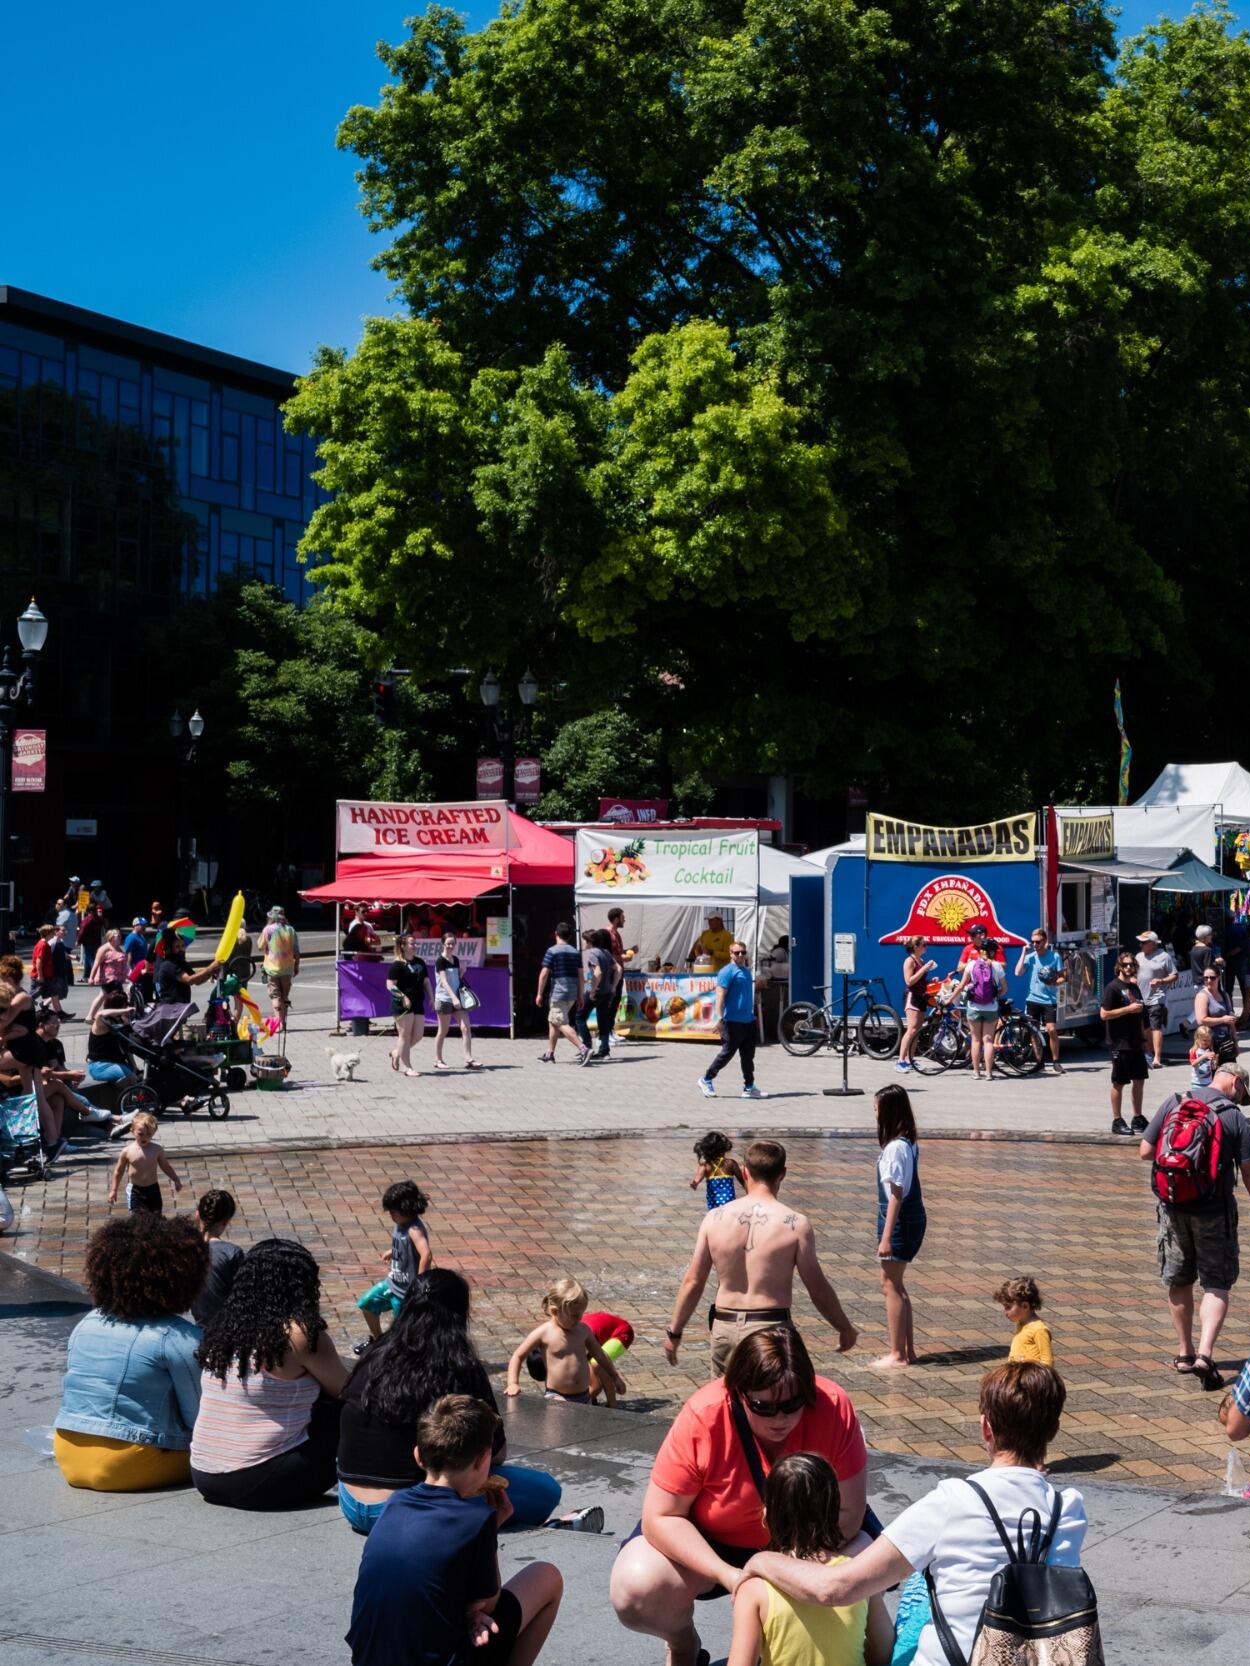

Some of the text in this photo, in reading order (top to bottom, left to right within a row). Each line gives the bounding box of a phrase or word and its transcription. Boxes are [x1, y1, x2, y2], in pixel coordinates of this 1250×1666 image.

[351, 807, 501, 826] HANDCRAFTED
[374, 828, 489, 845] ICE CREAM
[873, 819, 1029, 857] EMPANADAS
[1063, 819, 1111, 857] EMPANADAS
[654, 839, 756, 860] Tropical Fruit
[674, 867, 733, 884] Cocktail
[916, 892, 932, 917] PDX
[457, 942, 477, 956] NW
